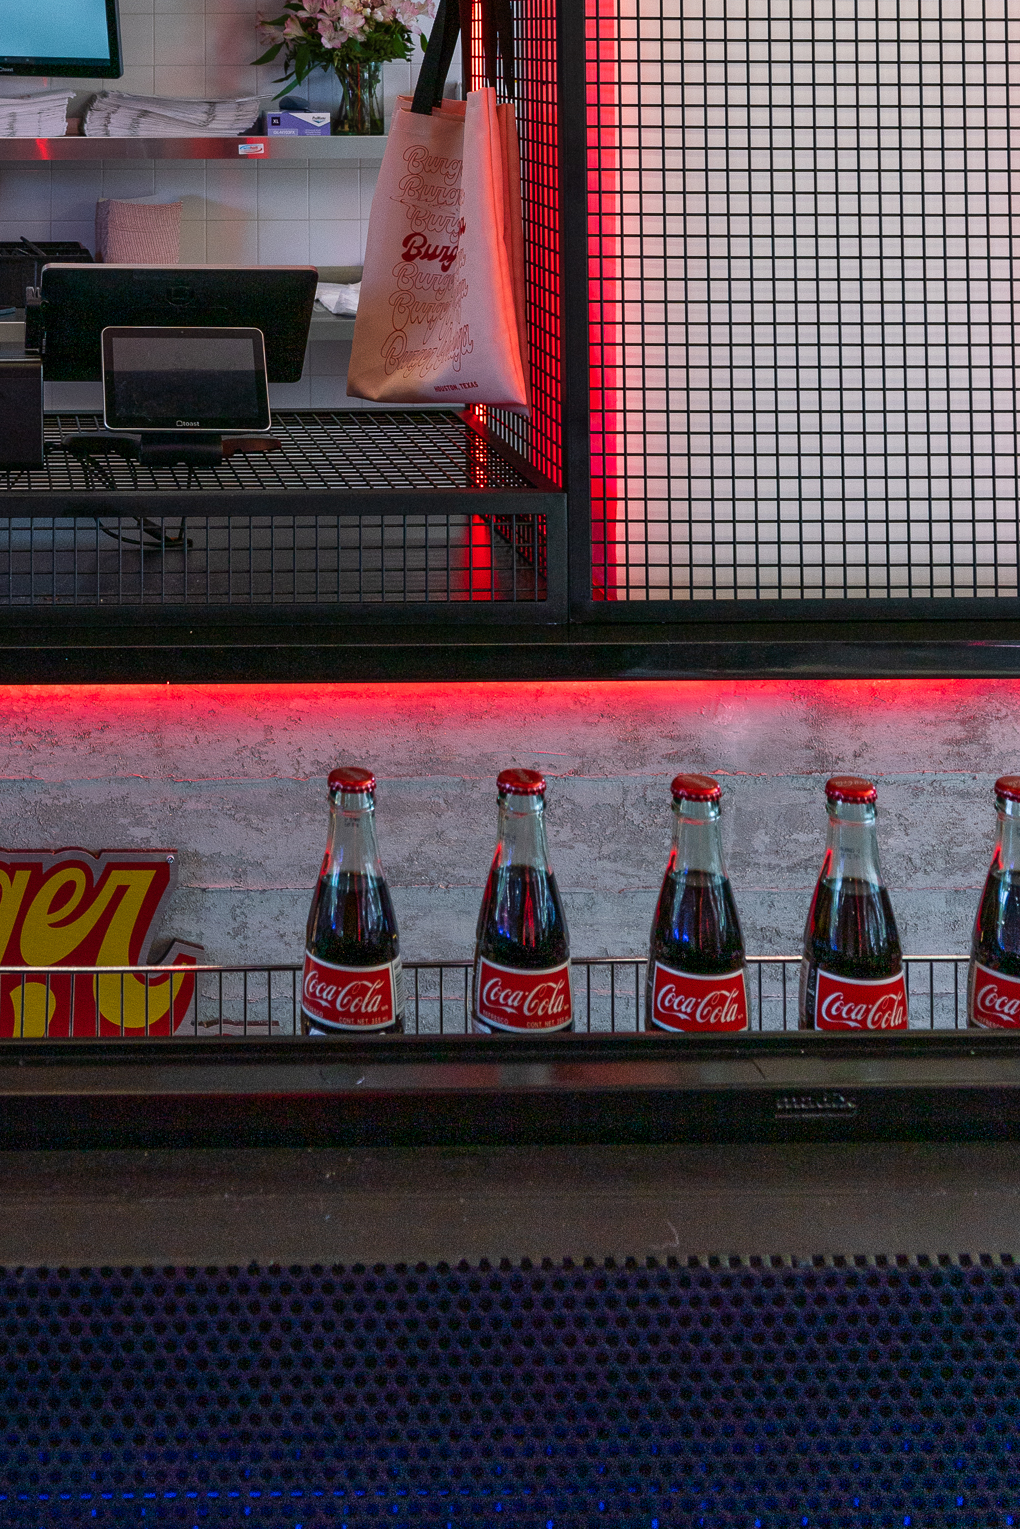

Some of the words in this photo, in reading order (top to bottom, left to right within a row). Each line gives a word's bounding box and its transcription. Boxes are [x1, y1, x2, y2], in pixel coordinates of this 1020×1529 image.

[403, 144, 463, 187] Burg
[399, 174, 465, 207] Burg
[401, 232, 459, 273] Burg
[392, 261, 456, 301] Burg
[459, 380, 479, 390] TEXAS
